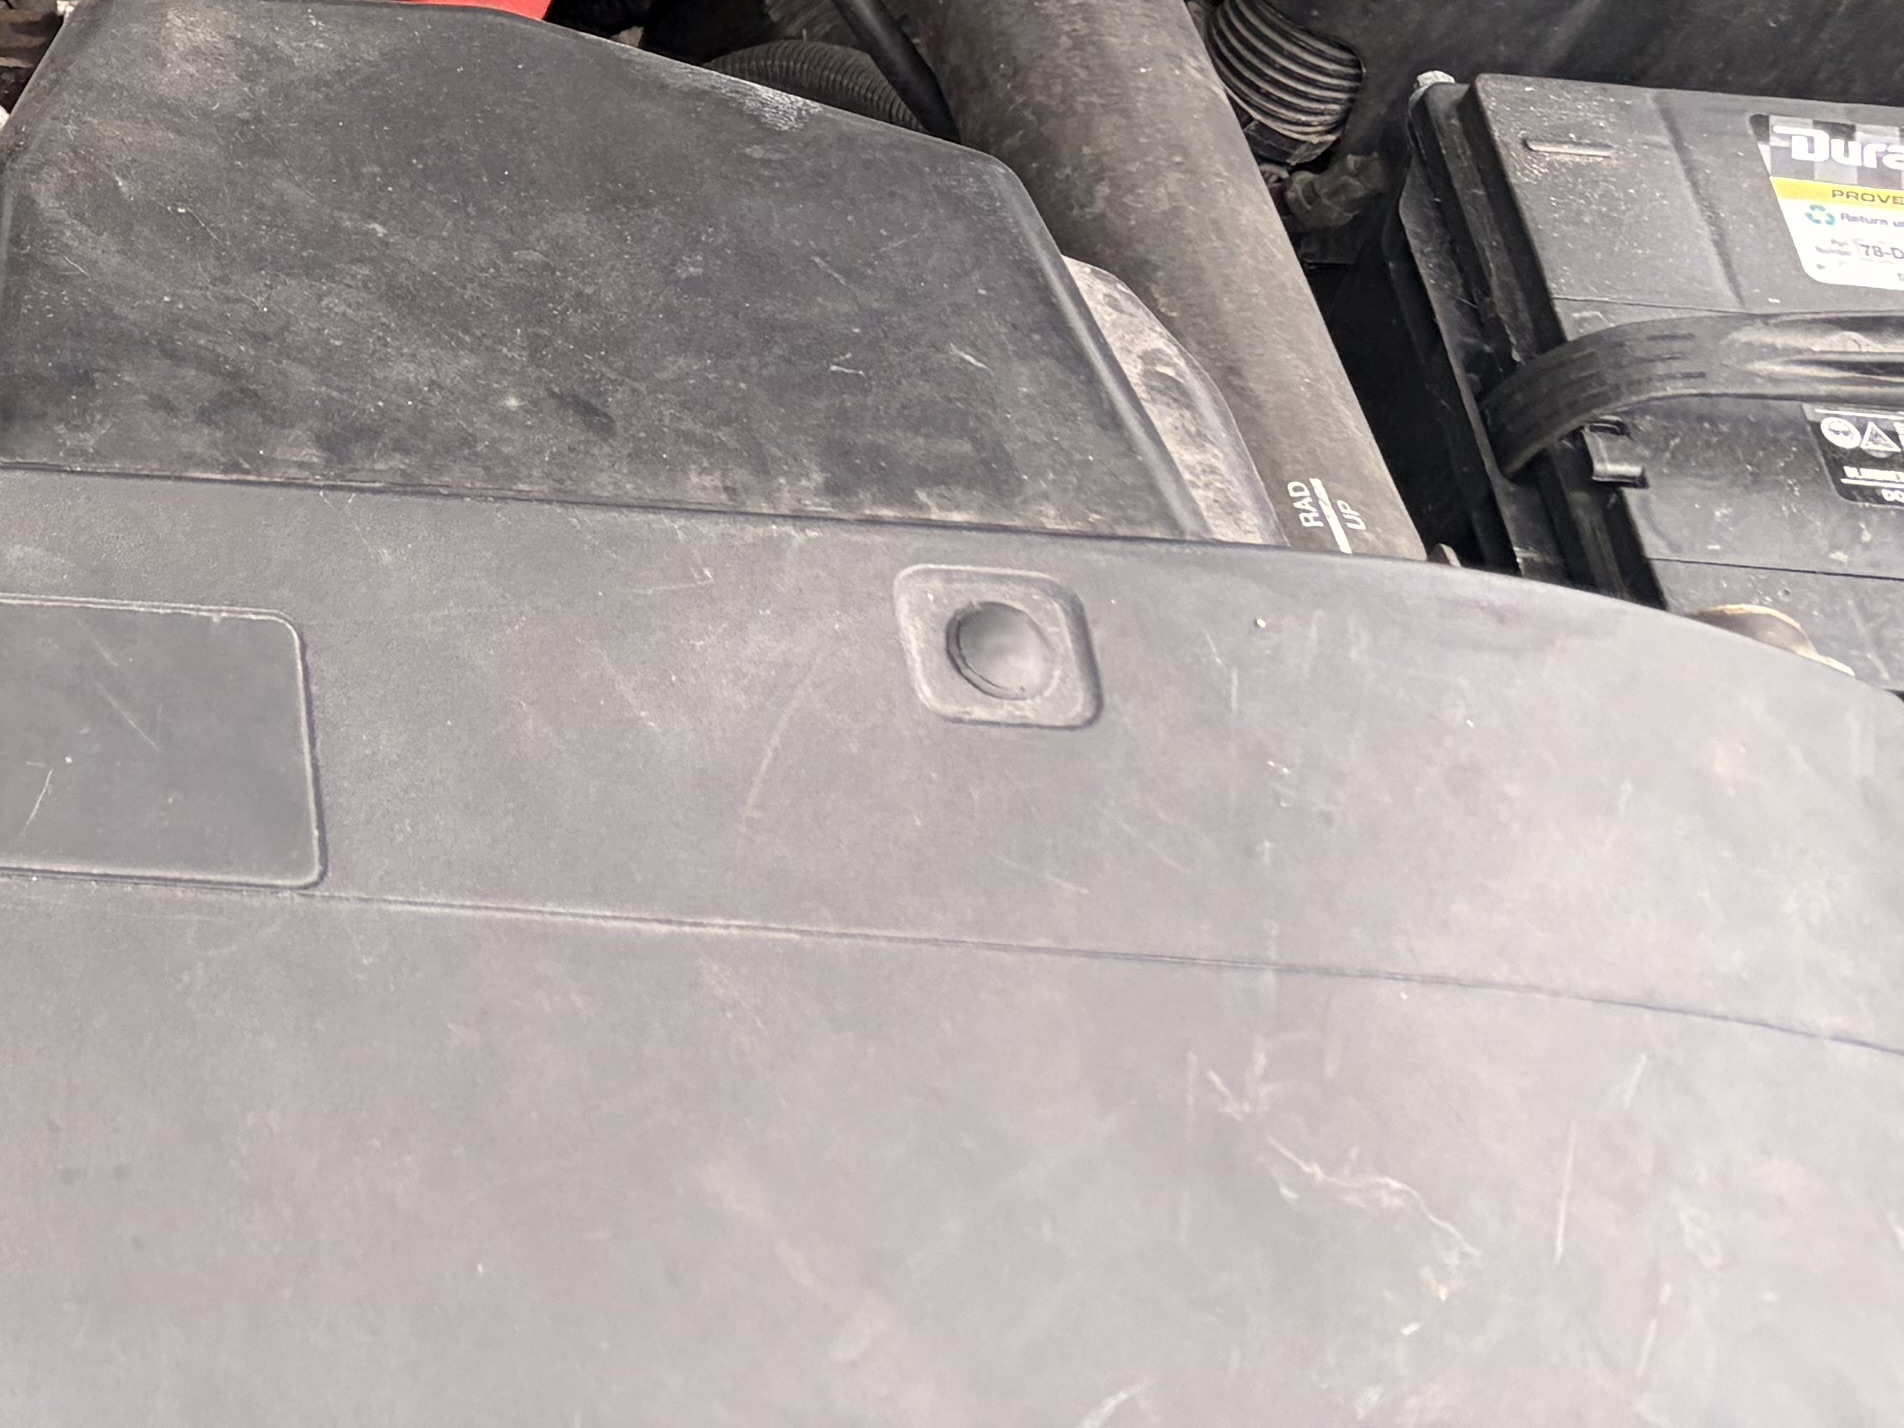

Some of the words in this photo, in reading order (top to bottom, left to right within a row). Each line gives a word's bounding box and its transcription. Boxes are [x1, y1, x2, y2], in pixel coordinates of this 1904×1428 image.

[1840, 211, 1889, 227] Return
[1287, 480, 1325, 529] RAD
[1342, 500, 1368, 533] UP
